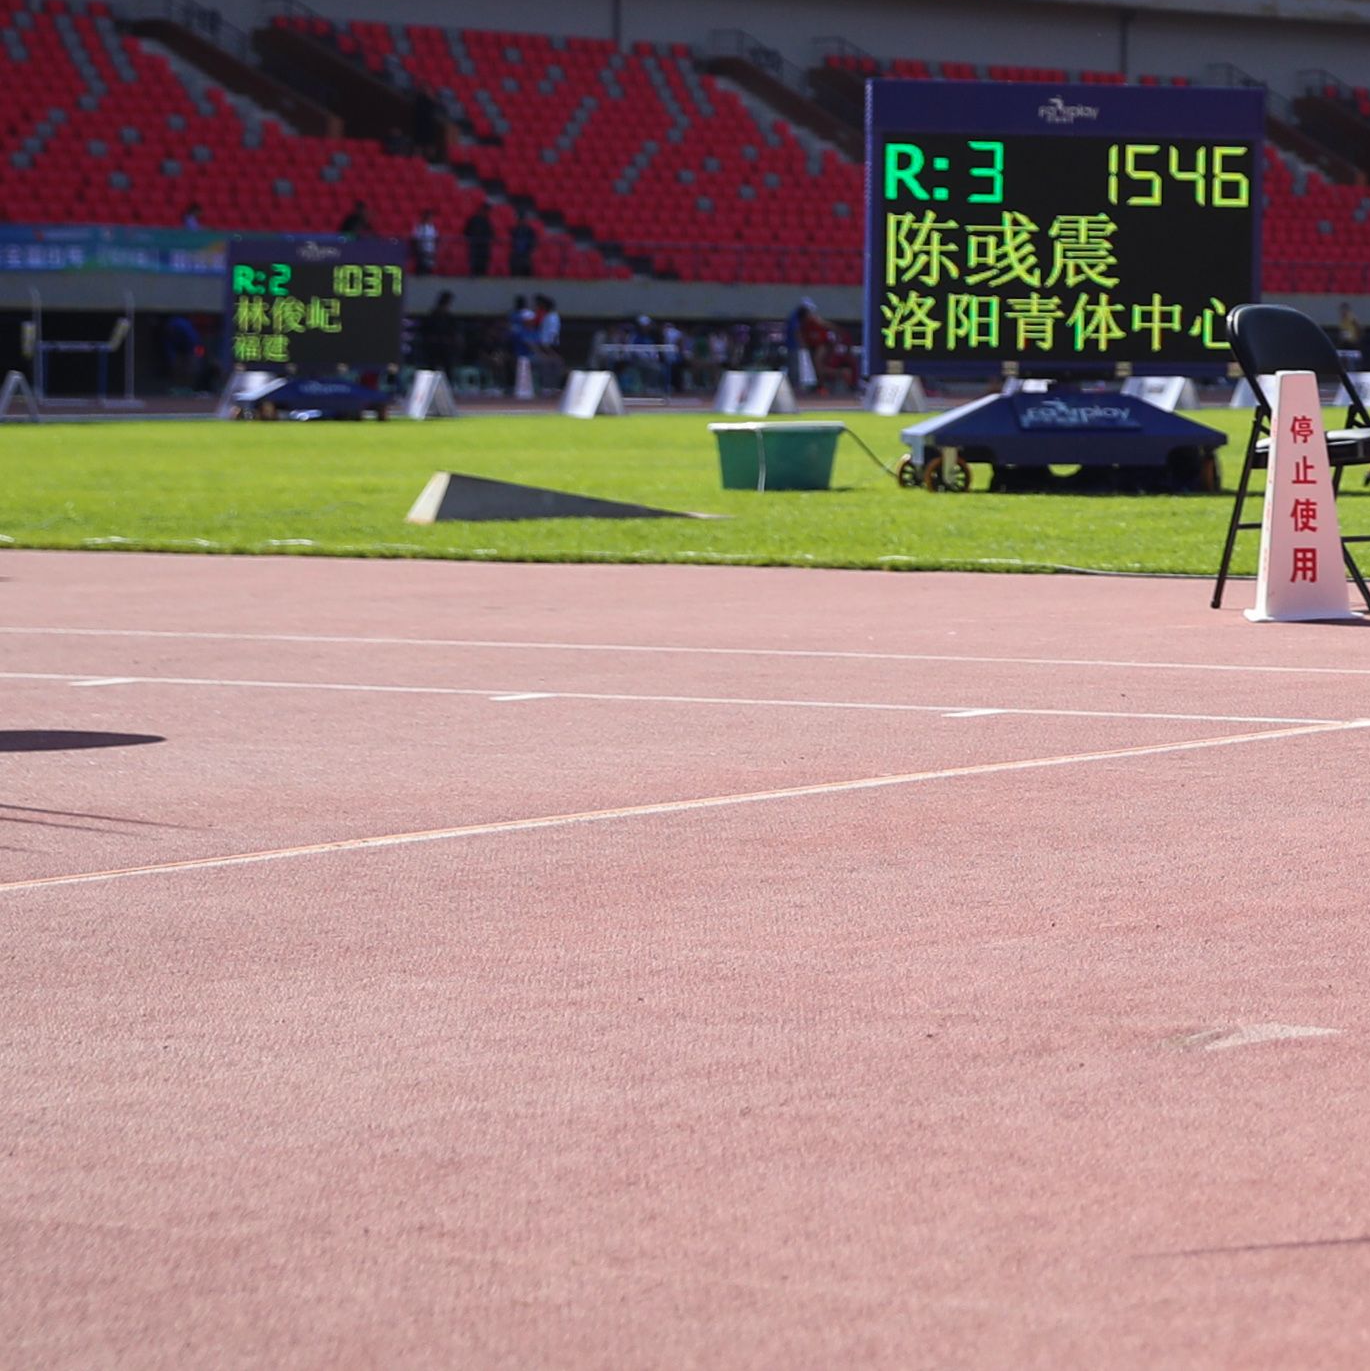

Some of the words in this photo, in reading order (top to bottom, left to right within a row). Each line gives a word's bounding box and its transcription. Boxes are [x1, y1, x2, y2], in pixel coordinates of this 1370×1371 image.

[1107, 144, 1249, 208] 1546
[333, 264, 403, 297] 1037
[885, 210, 1121, 289] 陈彧震
[233, 333, 290, 363] 福建
[880, 290, 1229, 352] 洛阳青体中心
[1289, 415, 1319, 584] 停止使用
